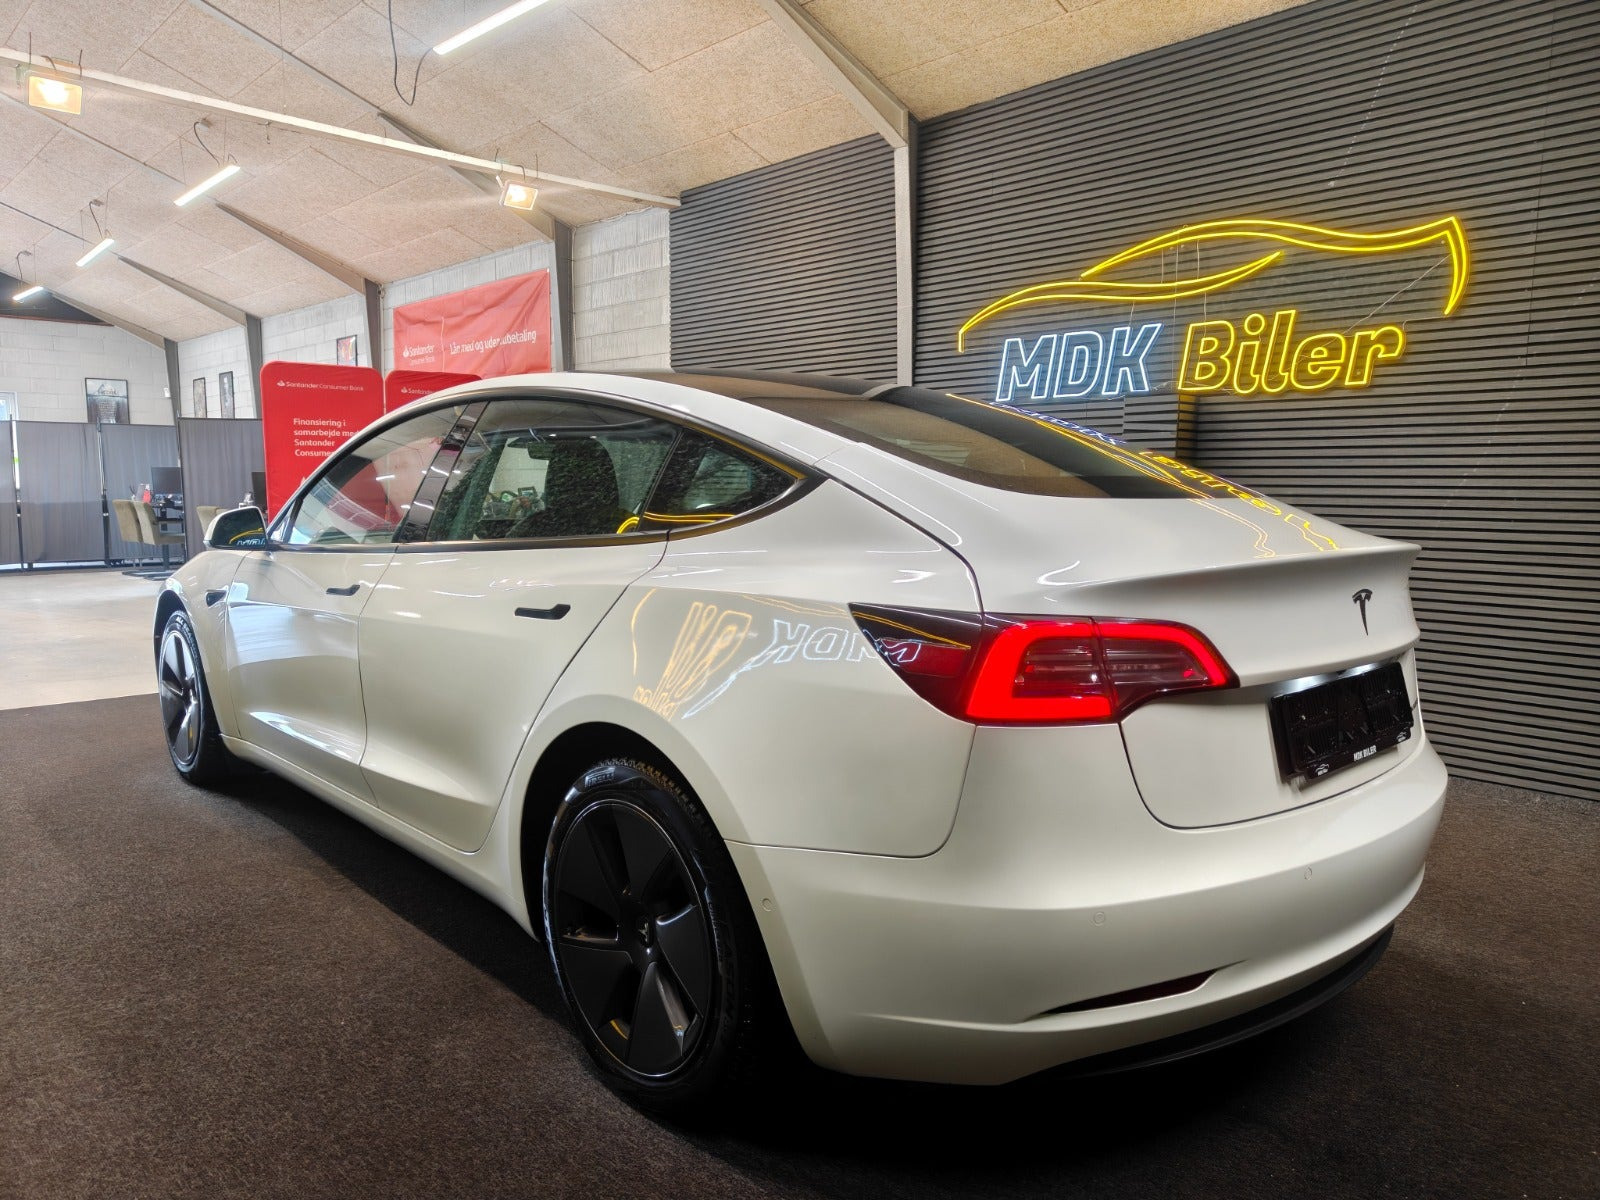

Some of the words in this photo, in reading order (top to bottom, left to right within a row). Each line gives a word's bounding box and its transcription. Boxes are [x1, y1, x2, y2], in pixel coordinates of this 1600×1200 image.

[995, 322, 1163, 402] MDK
[1177, 309, 1404, 394] Biler
[286, 381, 318, 389] Santander
[319, 383, 348, 391] Consumer
[293, 418, 342, 428] Finansiering
[293, 429, 341, 438] samarbejde
[294, 439, 335, 447] Santander
